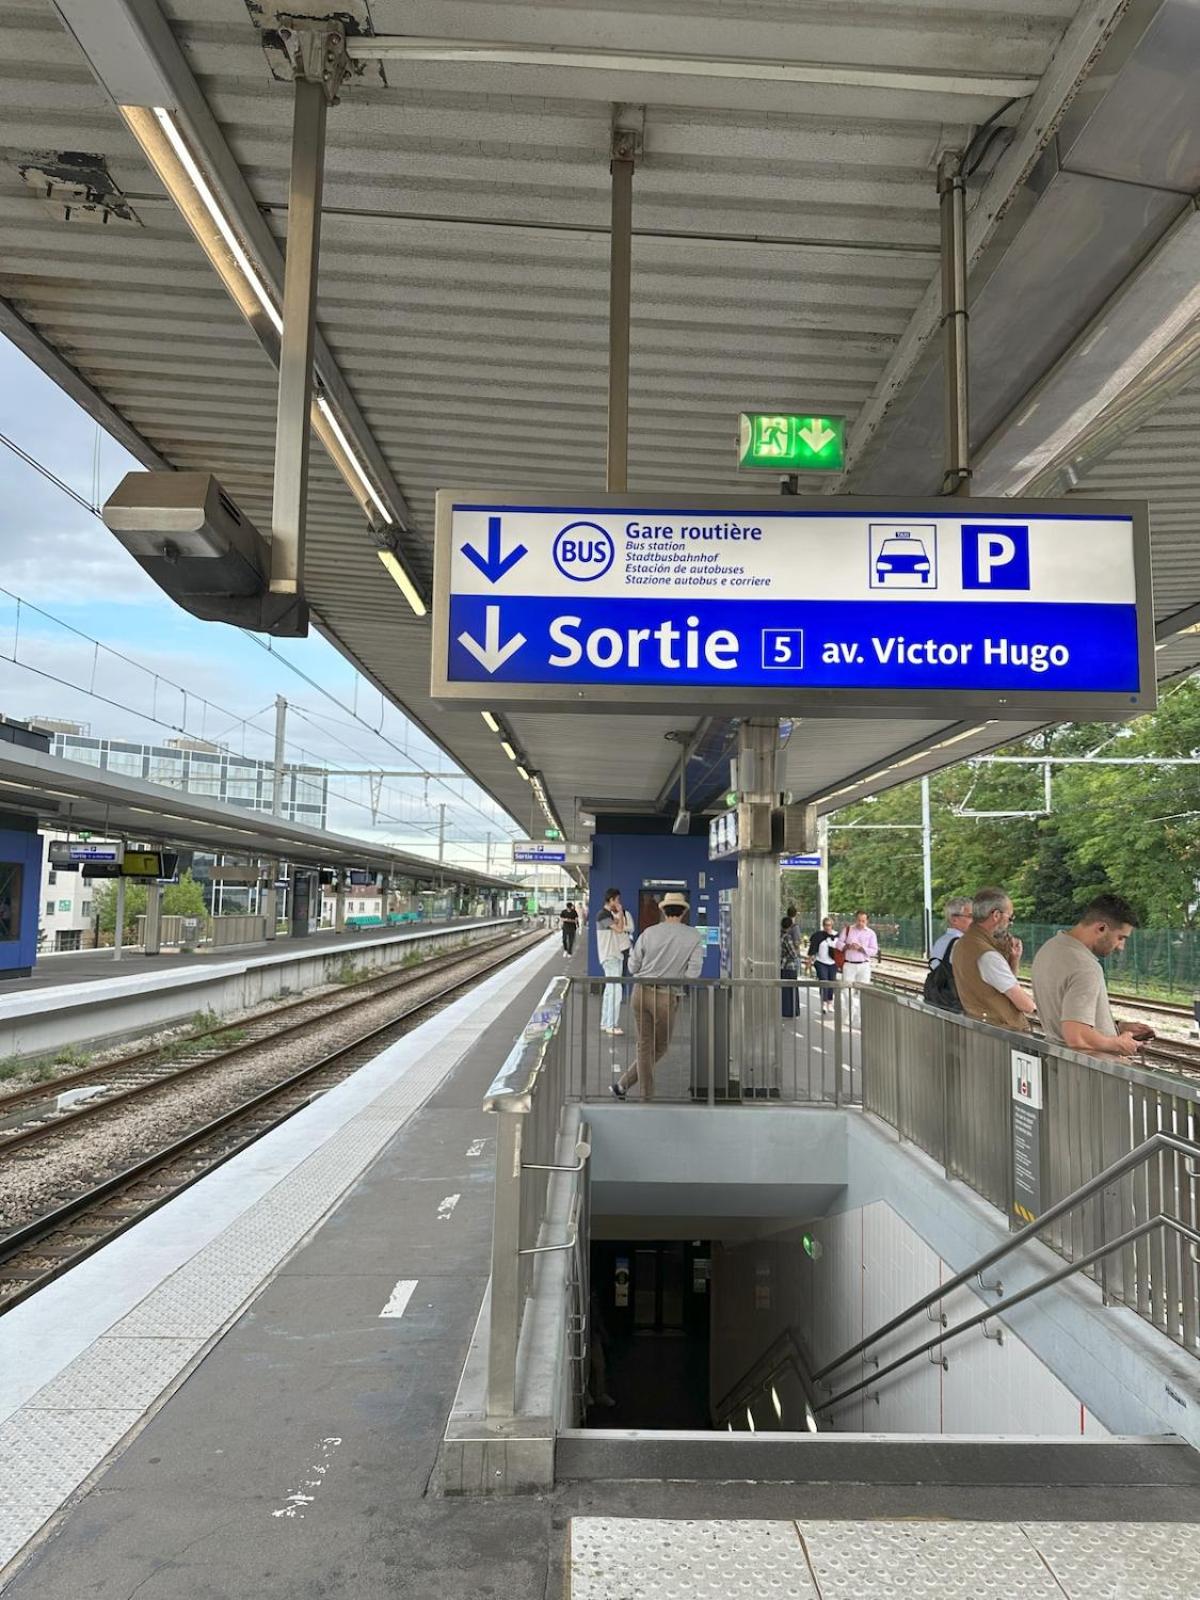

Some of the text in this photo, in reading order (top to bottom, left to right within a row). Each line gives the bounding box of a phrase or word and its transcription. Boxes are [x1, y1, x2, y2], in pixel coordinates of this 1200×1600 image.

[625, 522, 762, 540] Gare routière
[562, 541, 606, 562] BUS
[625, 541, 685, 551] Bus station
[625, 552, 719, 563] Stadtbusbahnhof
[978, 533, 1015, 583] P
[625, 563, 744, 575] Estación de autobuses
[625, 574, 771, 586] Stazione autobus e corriere
[548, 615, 1069, 672] Sortie 5 av. Victor Hugo
